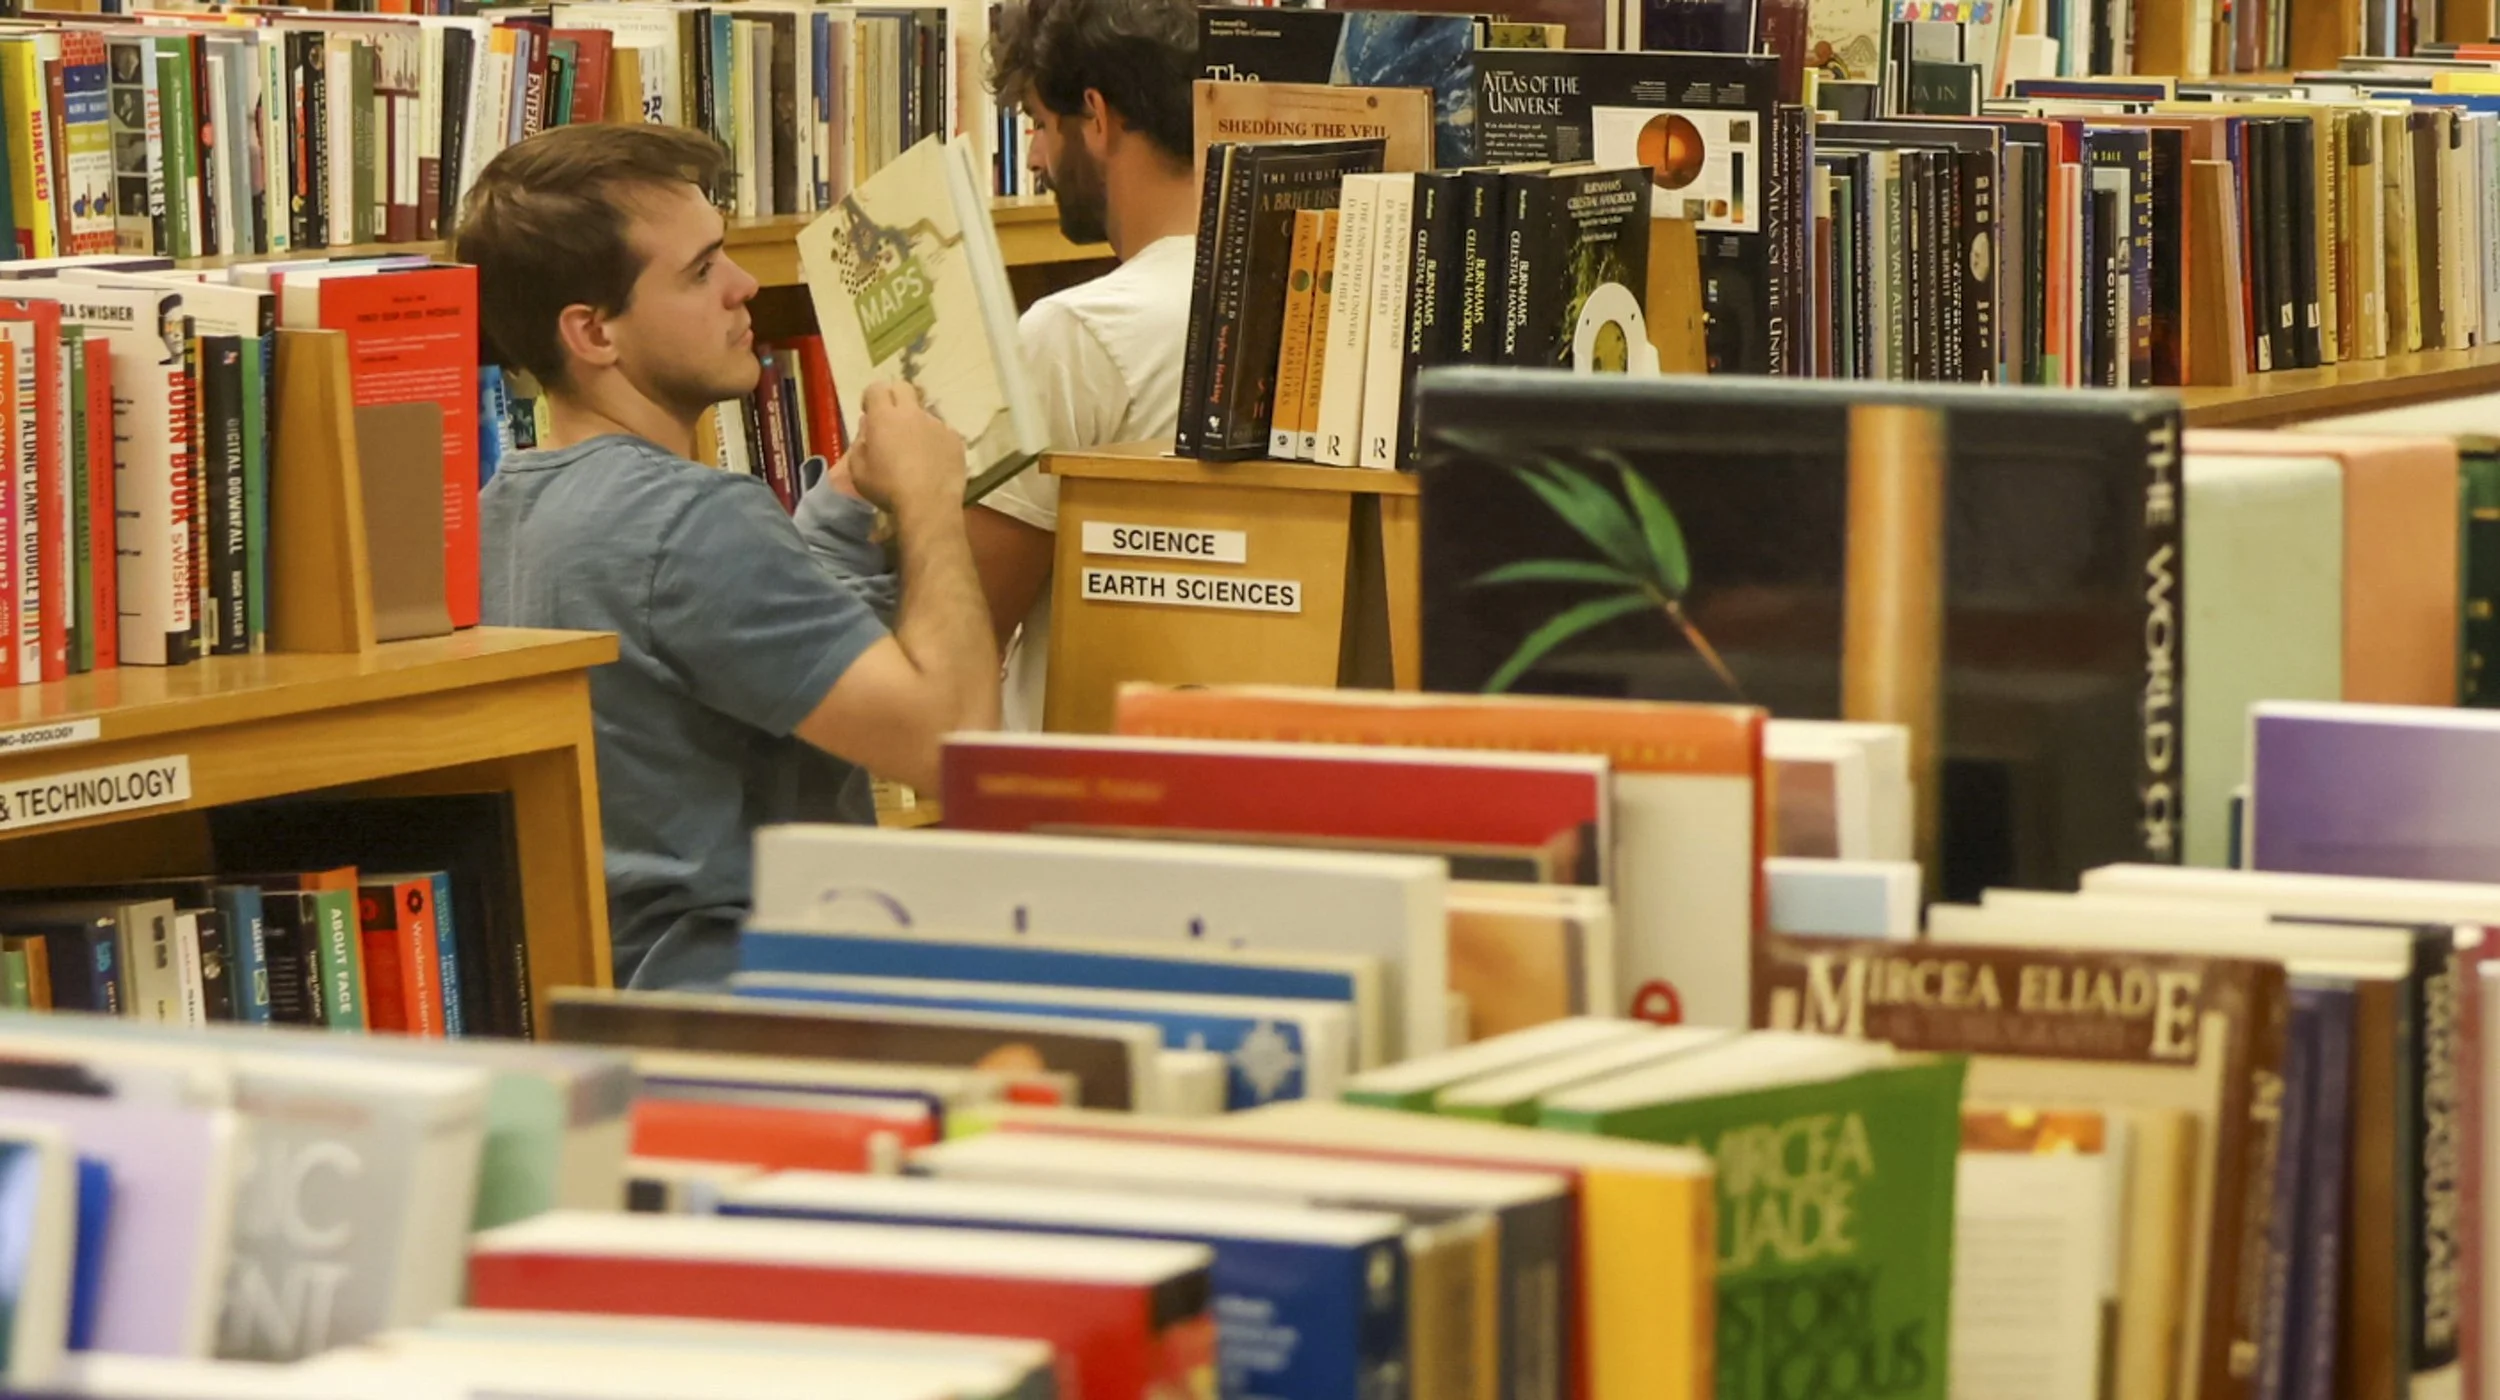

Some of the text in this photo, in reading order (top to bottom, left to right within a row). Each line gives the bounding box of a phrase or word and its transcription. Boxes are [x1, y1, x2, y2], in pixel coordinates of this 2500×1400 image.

[1488, 91, 1563, 116] UNIVERSE
[1529, 75, 1549, 94] OF
[1552, 75, 1581, 95] THE
[31, 110, 49, 201] HIJACKED
[1218, 119, 1391, 140] SHEDDING THE VEIL
[1794, 223, 1802, 271] MOON
[1890, 186, 1903, 347] JAMES VAN ALLEN
[79, 303, 135, 322] SWISHER
[859, 267, 925, 335] MAPS
[1410, 229, 1428, 354] CELESTIAL HANDBOOK
[1461, 228, 1477, 353] CELESTIAL HANDBOOK
[1504, 230, 1521, 355] CELESTIAL HANDBOOK
[1281, 338, 1298, 407] MASTERS
[1309, 346, 1325, 408] MASTERS
[167, 371, 190, 526] BURN BOOK
[227, 418, 243, 555] DIGITAL DOWNFALL
[2146, 423, 2174, 525] THE
[22, 419, 41, 596] ALONG CAME GOOGLE
[1112, 527, 1216, 556] SCIENCE
[171, 532, 186, 623] SWISHER
[231, 570, 244, 637] HUGH TAYLOR
[1087, 573, 1295, 606] EARTH SCIENCES
[2145, 544, 2174, 774] WORLD
[15, 766, 177, 818] TECHNOLOGY
[330, 908, 352, 1015] ABOUT FACE
[411, 919, 428, 989] Windows
[1806, 953, 2200, 1059] MIRCEA ELIADE
